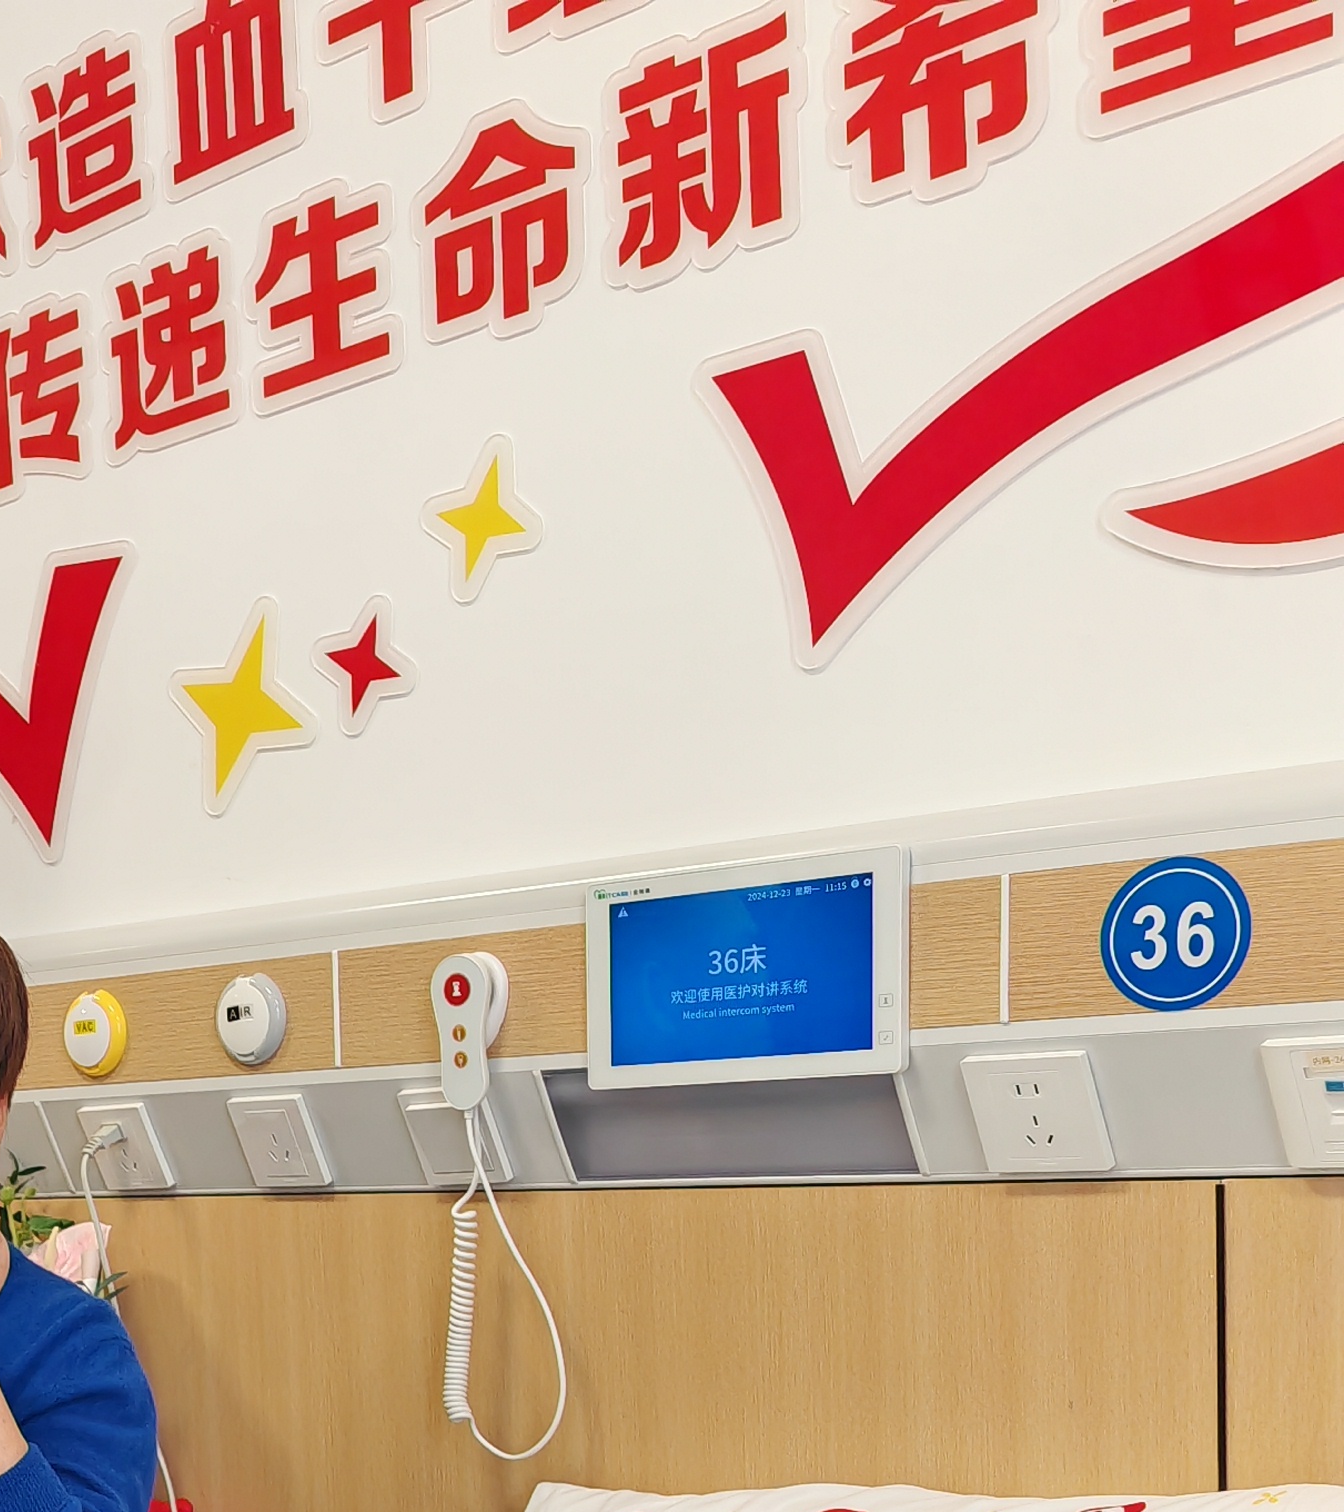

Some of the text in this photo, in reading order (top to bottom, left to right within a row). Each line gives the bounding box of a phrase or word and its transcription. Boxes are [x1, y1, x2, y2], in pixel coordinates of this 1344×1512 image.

[747, 882, 847, 901] 2024-12-23 星期一 11:15
[1129, 901, 1216, 970] 36
[708, 944, 767, 975] 36床
[670, 979, 808, 1005] 欢迎使用医护对讲系统
[229, 1006, 253, 1020] AIR
[682, 1003, 795, 1020] Medical intercom system
